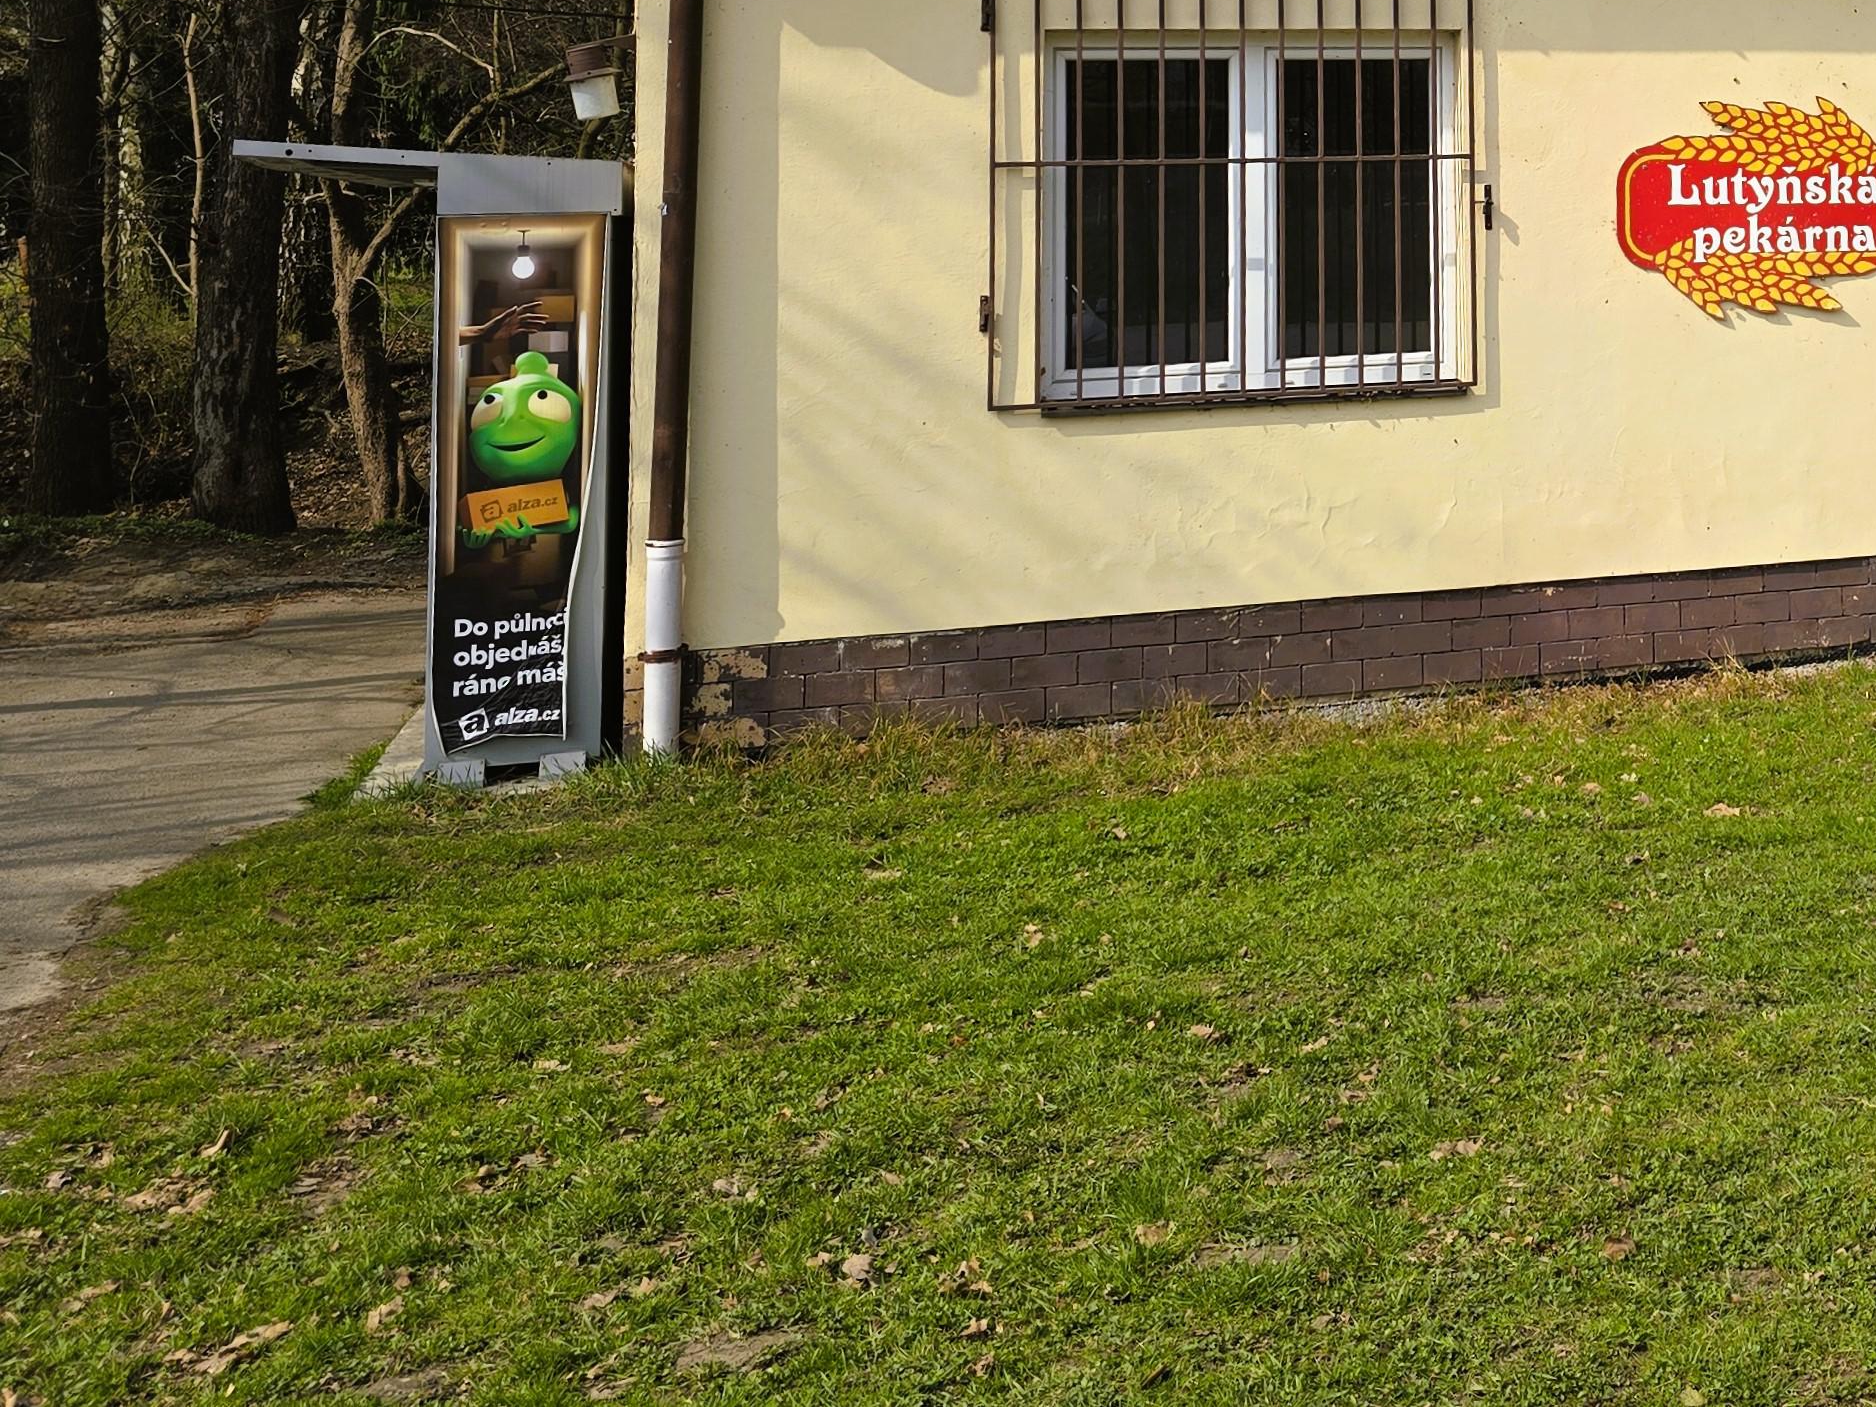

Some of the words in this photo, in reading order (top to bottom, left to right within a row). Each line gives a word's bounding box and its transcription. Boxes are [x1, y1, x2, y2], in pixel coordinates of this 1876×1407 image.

[507, 497, 559, 513] alza.cz
[454, 619, 488, 638] Do
[453, 673, 512, 697] ráno
[517, 661, 566, 686] máš
[494, 707, 561, 726] alza.cz
